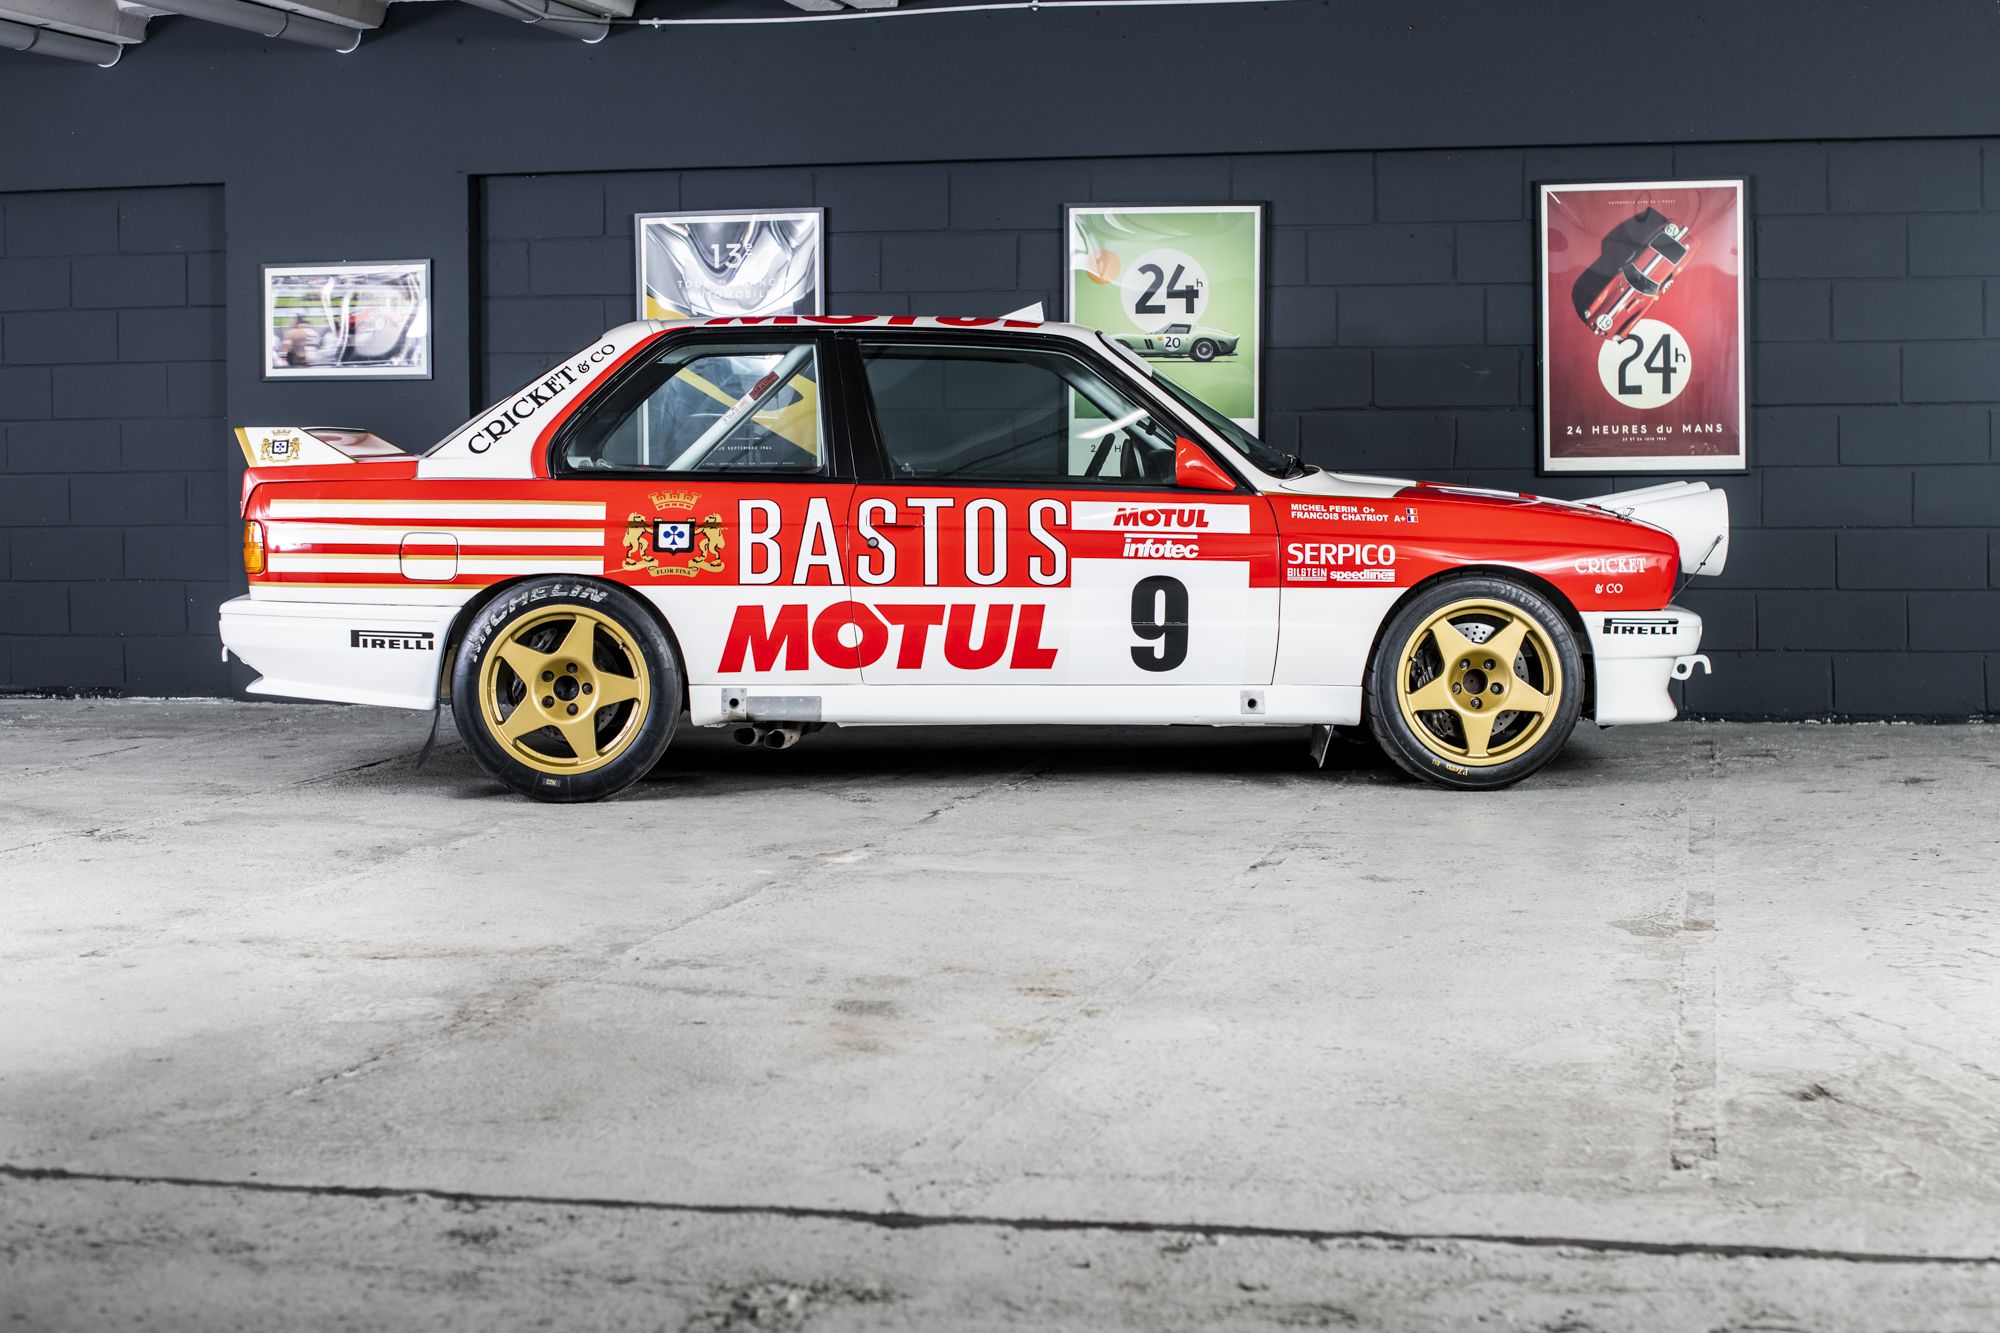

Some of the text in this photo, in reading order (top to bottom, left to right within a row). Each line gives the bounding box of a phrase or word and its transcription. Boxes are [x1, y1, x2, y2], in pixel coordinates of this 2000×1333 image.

[1165, 336, 1181, 348] 20
[468, 344, 616, 454] CRICKET & CO
[1566, 423, 1723, 435] 24 HEURES du MANS
[1290, 503, 1327, 512] MICHEL
[1329, 505, 1358, 513] PERIN
[1291, 512, 1406, 522] FRANCOIS CHATRIOT A+
[1113, 507, 1209, 528] MOTUL
[738, 497, 1068, 587] BASTOS
[1123, 538, 1199, 558] infotec
[1287, 543, 1396, 566] SERPICO
[656, 568, 691, 576] FLOR FINA
[1287, 567, 1392, 582] BILSTEIN speedline
[1575, 557, 1647, 574] CRICKET
[1594, 583, 1624, 594] & CO
[469, 583, 609, 663] MICHELIN
[1130, 575, 1189, 673] 9
[1603, 618, 1679, 635] PIRELLI
[351, 629, 434, 651] PIRELLI
[717, 600, 1059, 673] MOTUL
